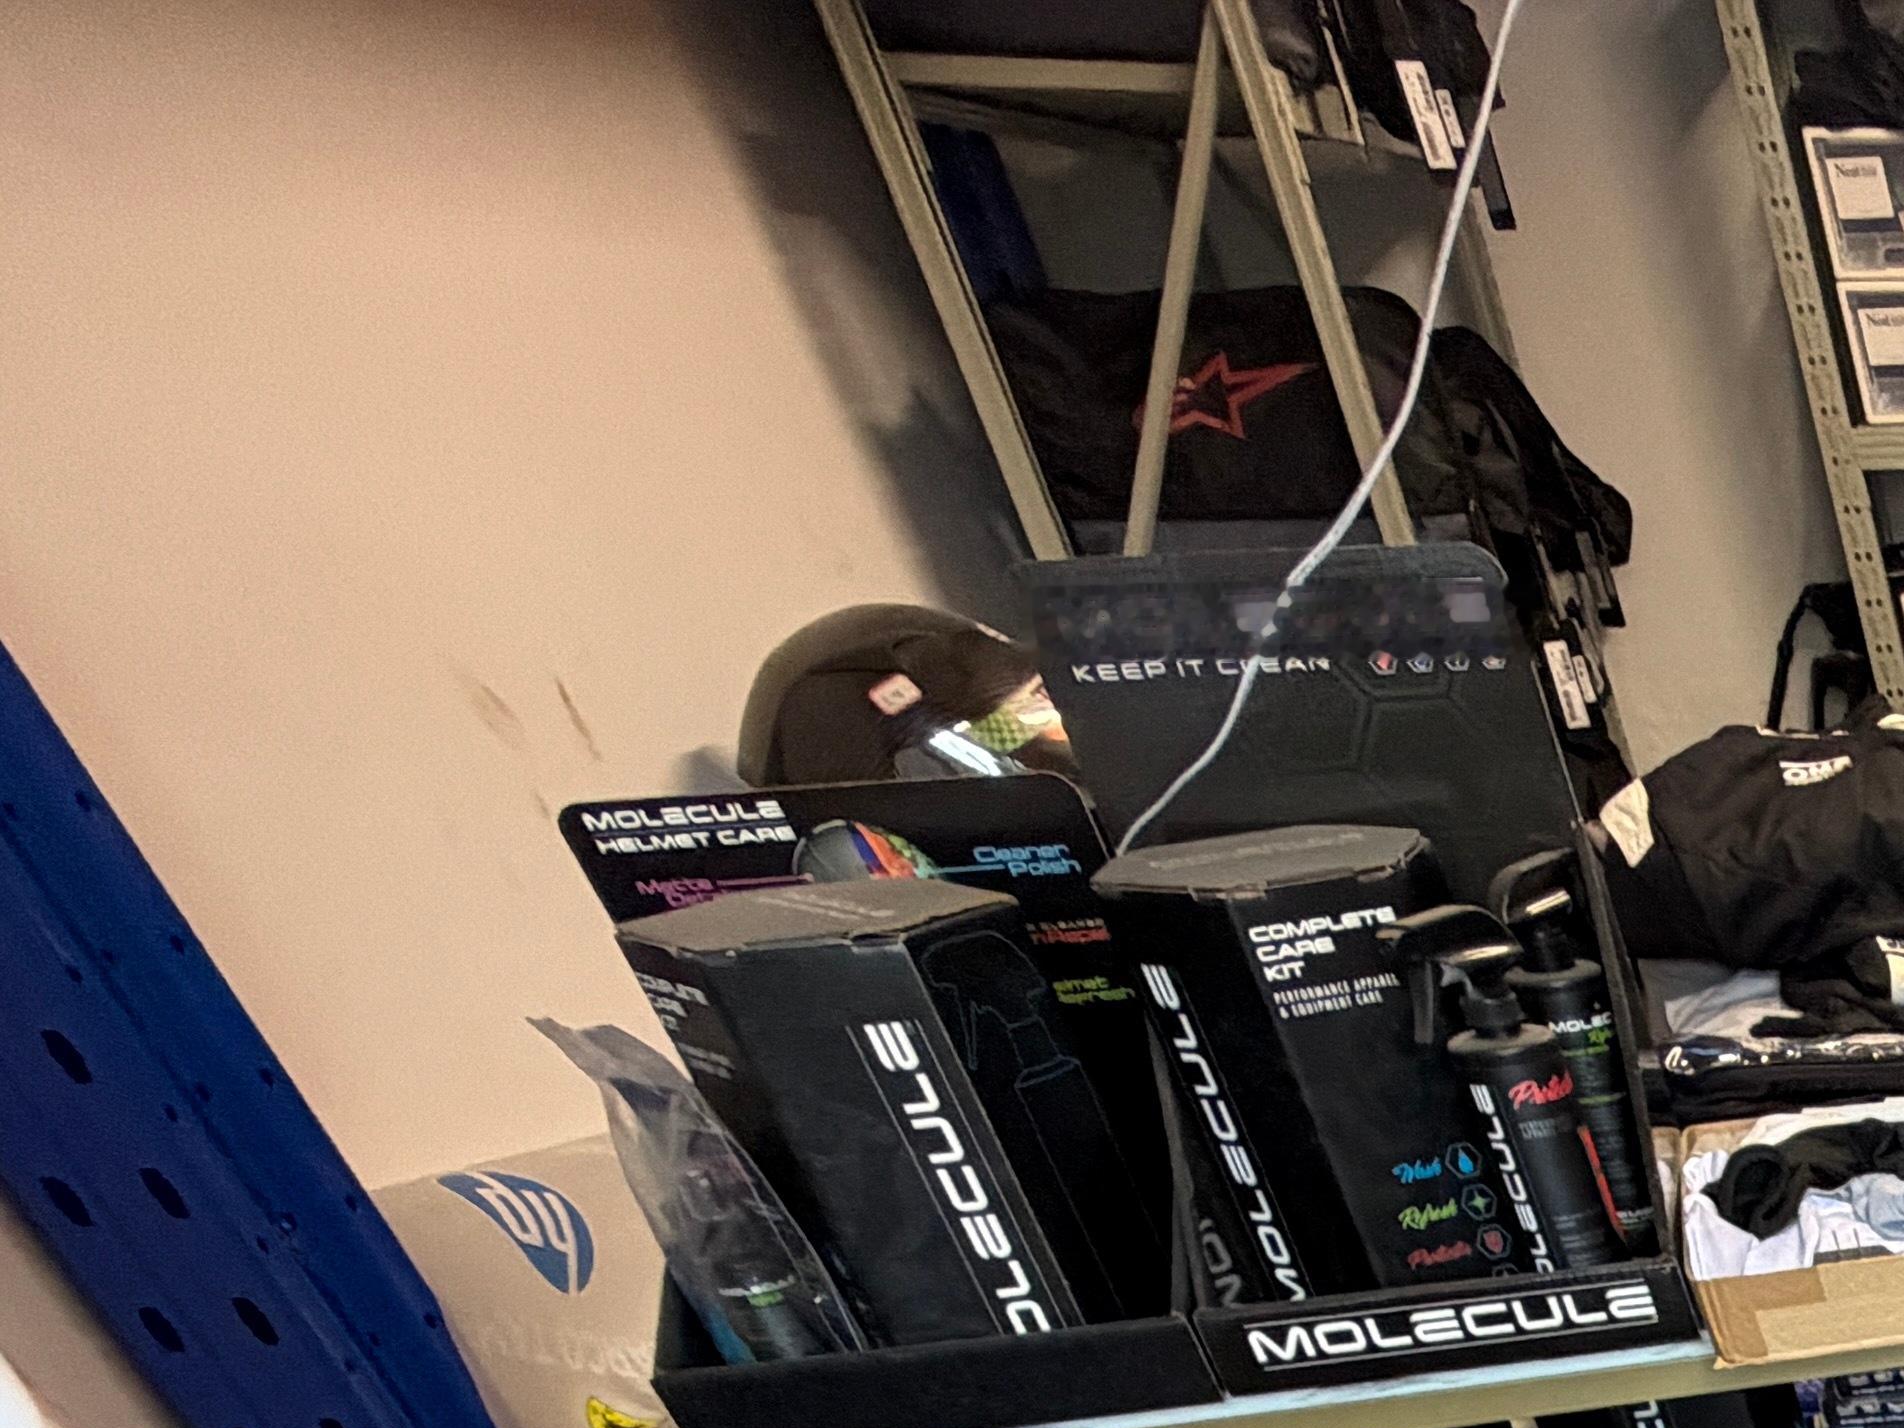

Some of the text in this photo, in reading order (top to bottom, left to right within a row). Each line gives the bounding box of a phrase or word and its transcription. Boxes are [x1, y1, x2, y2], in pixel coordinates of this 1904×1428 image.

[1072, 660, 1168, 684] KEEP
[1175, 658, 1202, 679] IT
[581, 799, 786, 833] MOLECULE
[594, 824, 798, 856] HELMET CARE
[972, 843, 1070, 864] Cleaner
[1006, 858, 1083, 878] Polish
[1248, 905, 1397, 943] COMPLETE
[1255, 934, 1337, 964] CARE
[1262, 959, 1307, 984] KIT
[861, 1018, 1061, 1337] OLECULE
[1467, 1083, 1556, 1274] OLECULE
[463, 1170, 592, 1295] hp
[1248, 1283, 1657, 1367] MOLECULE
